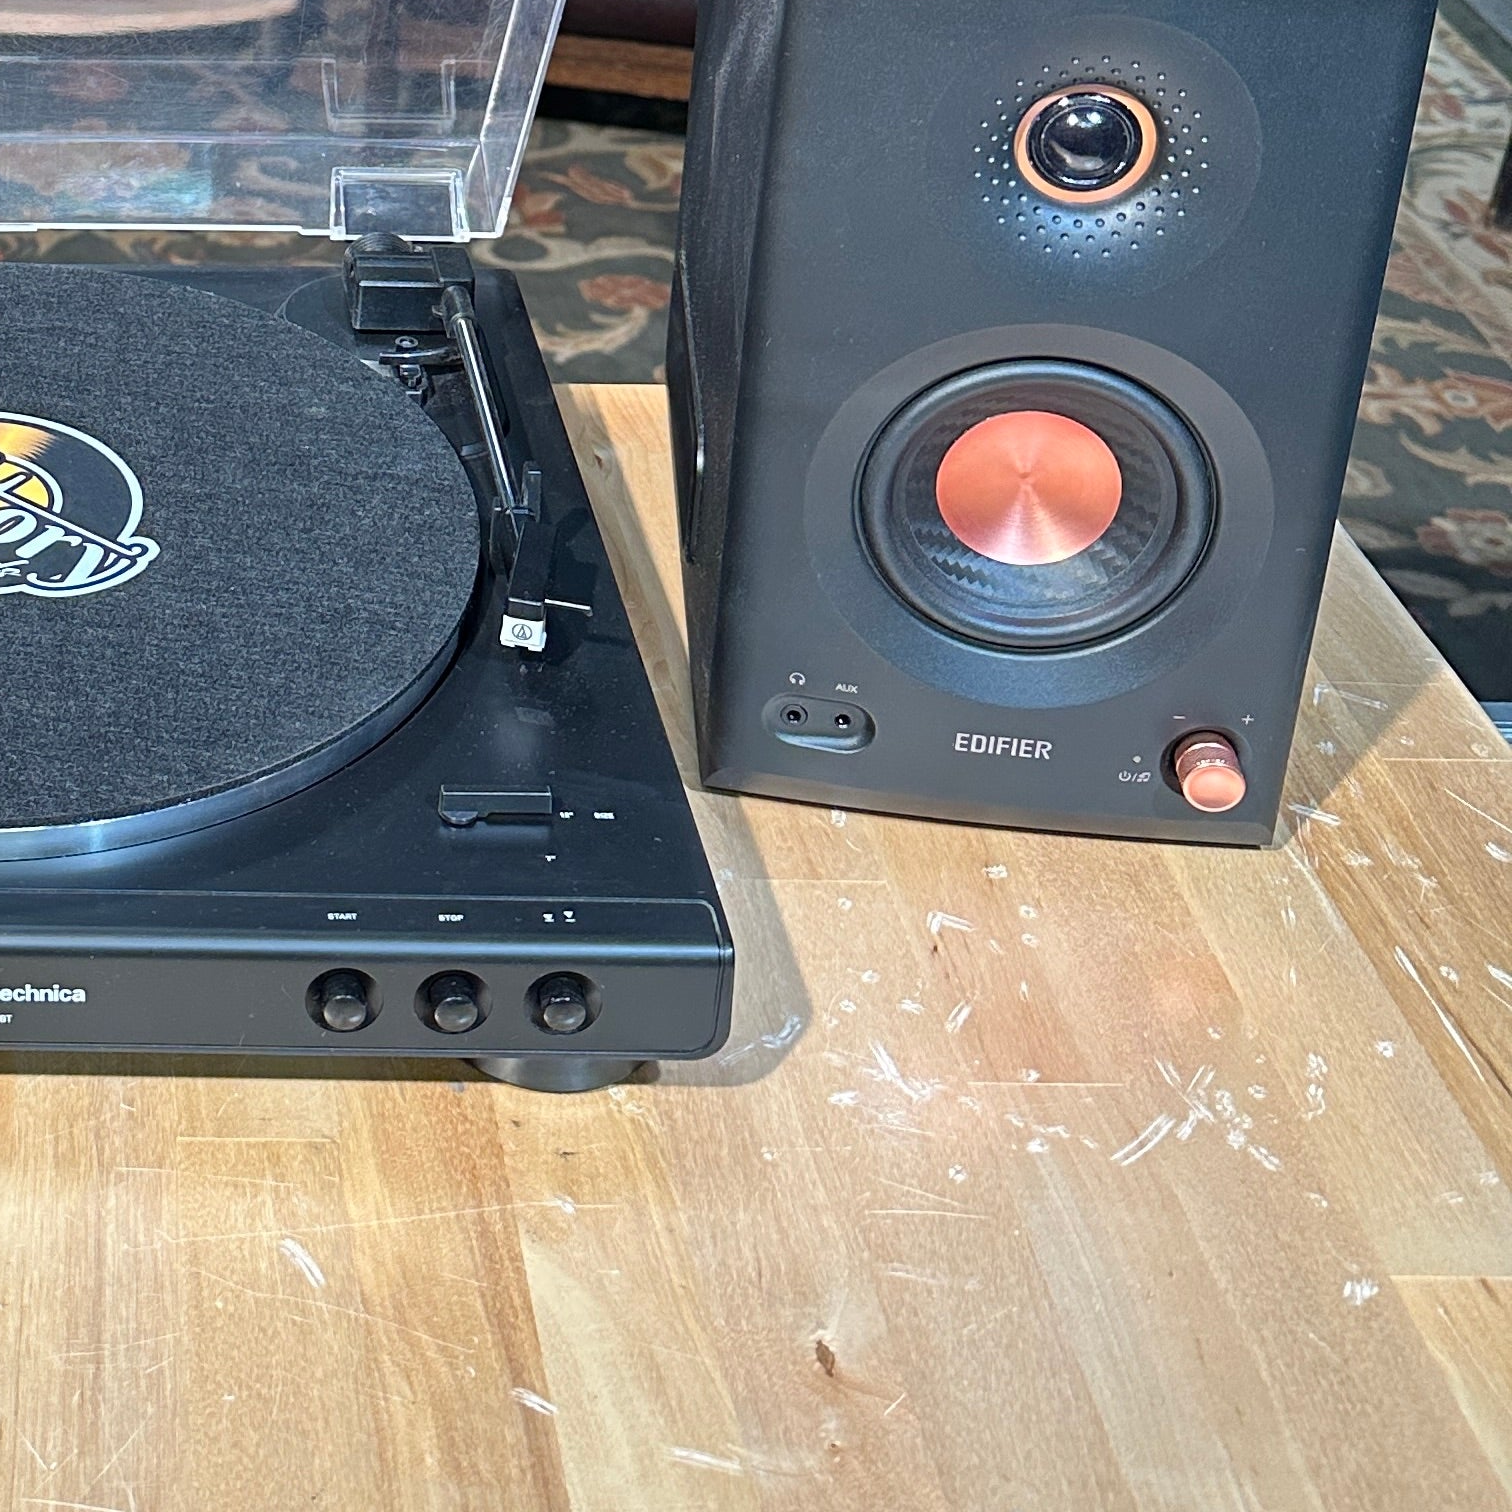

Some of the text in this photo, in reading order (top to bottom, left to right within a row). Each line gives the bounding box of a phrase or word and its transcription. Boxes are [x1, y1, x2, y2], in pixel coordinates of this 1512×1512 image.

[835, 683, 858, 694] AUX
[954, 732, 1053, 760] EDIFIER
[327, 912, 358, 921] START
[438, 914, 465, 922] STOP
